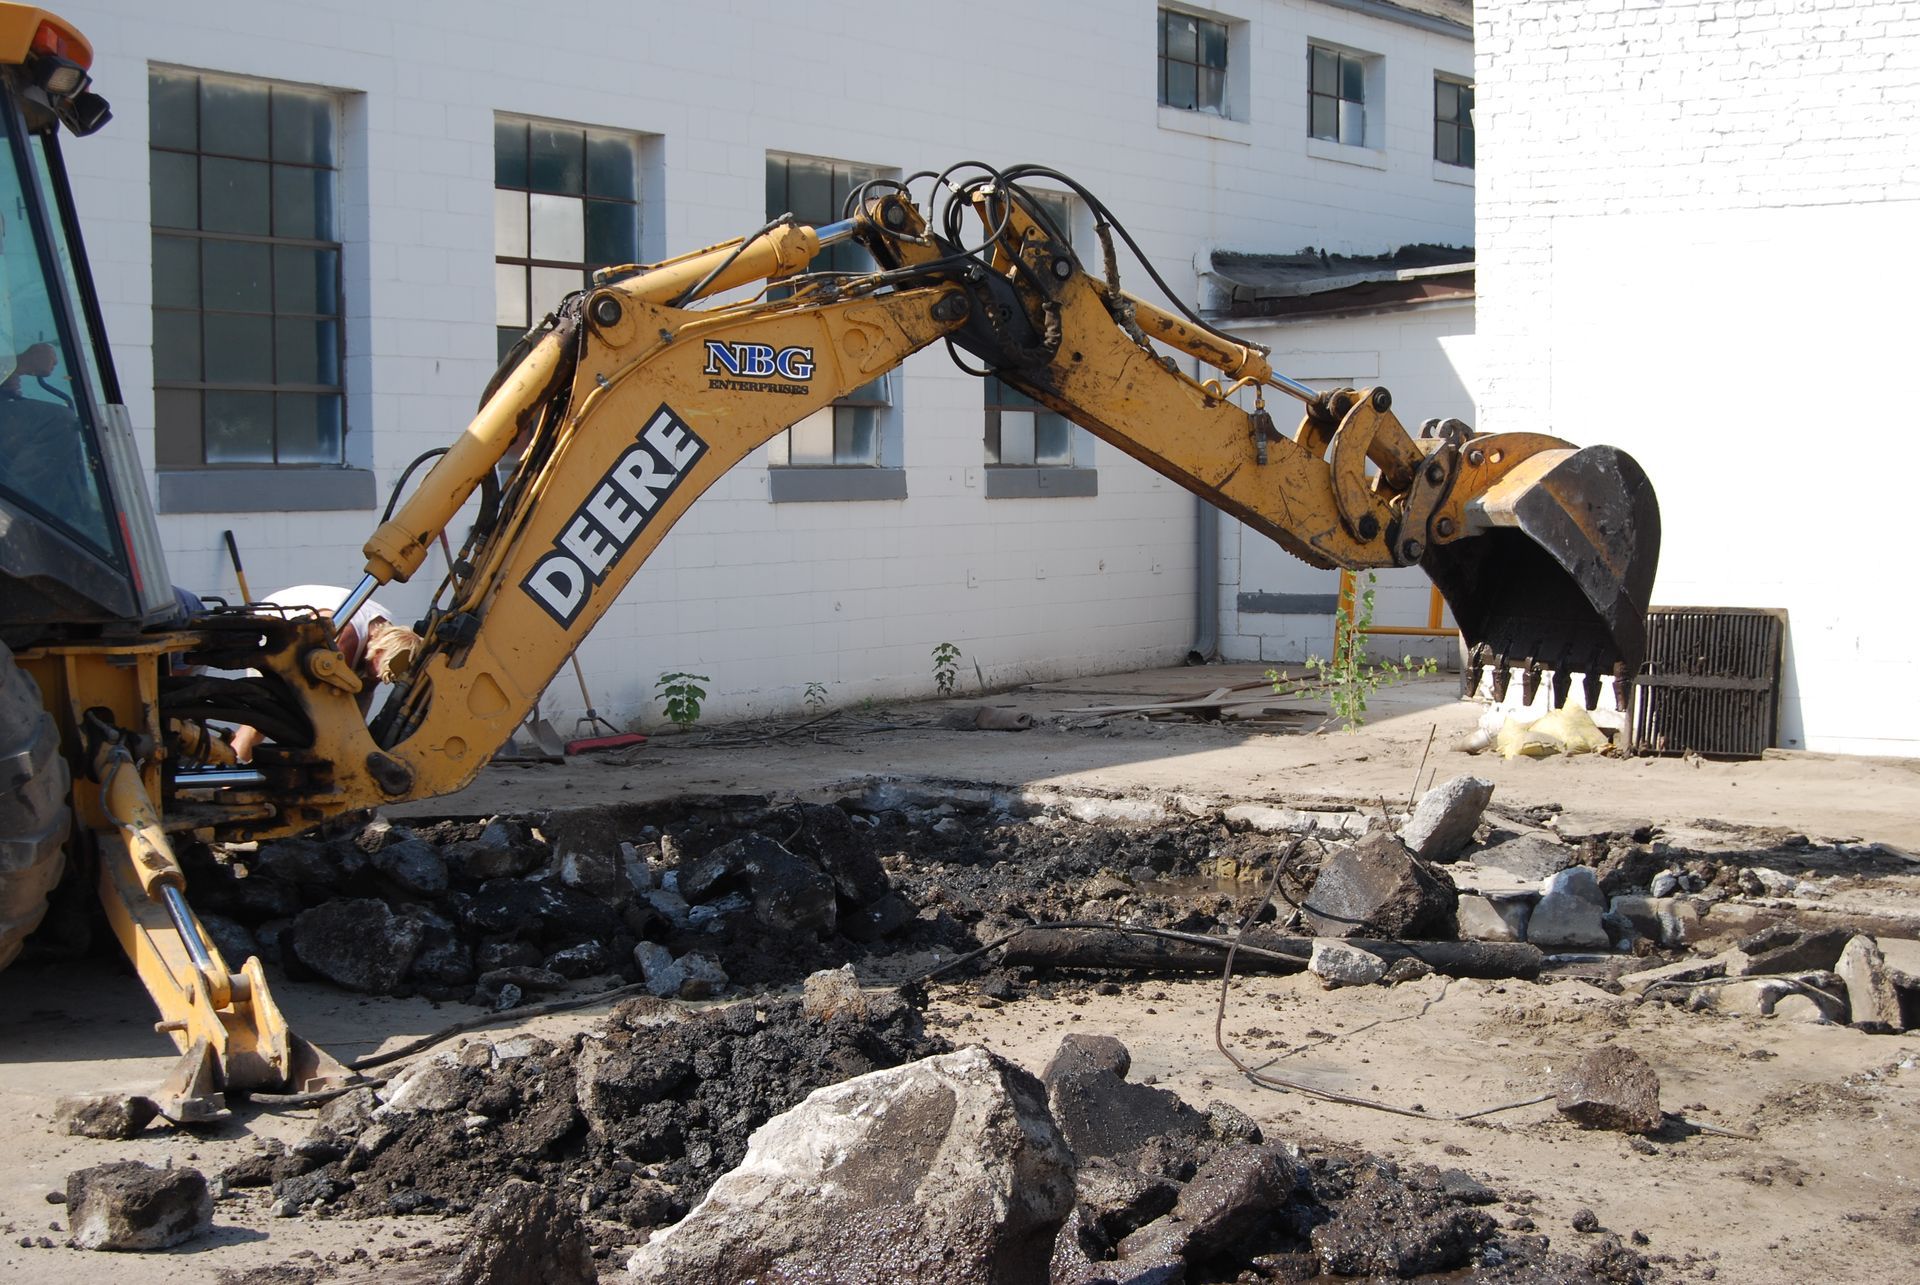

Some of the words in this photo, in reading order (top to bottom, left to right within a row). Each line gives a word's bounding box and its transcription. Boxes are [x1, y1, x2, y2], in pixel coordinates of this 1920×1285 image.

[704, 340, 815, 380] NBG
[708, 379, 809, 395] ENTERPRISES
[526, 410, 702, 620] DEERE
